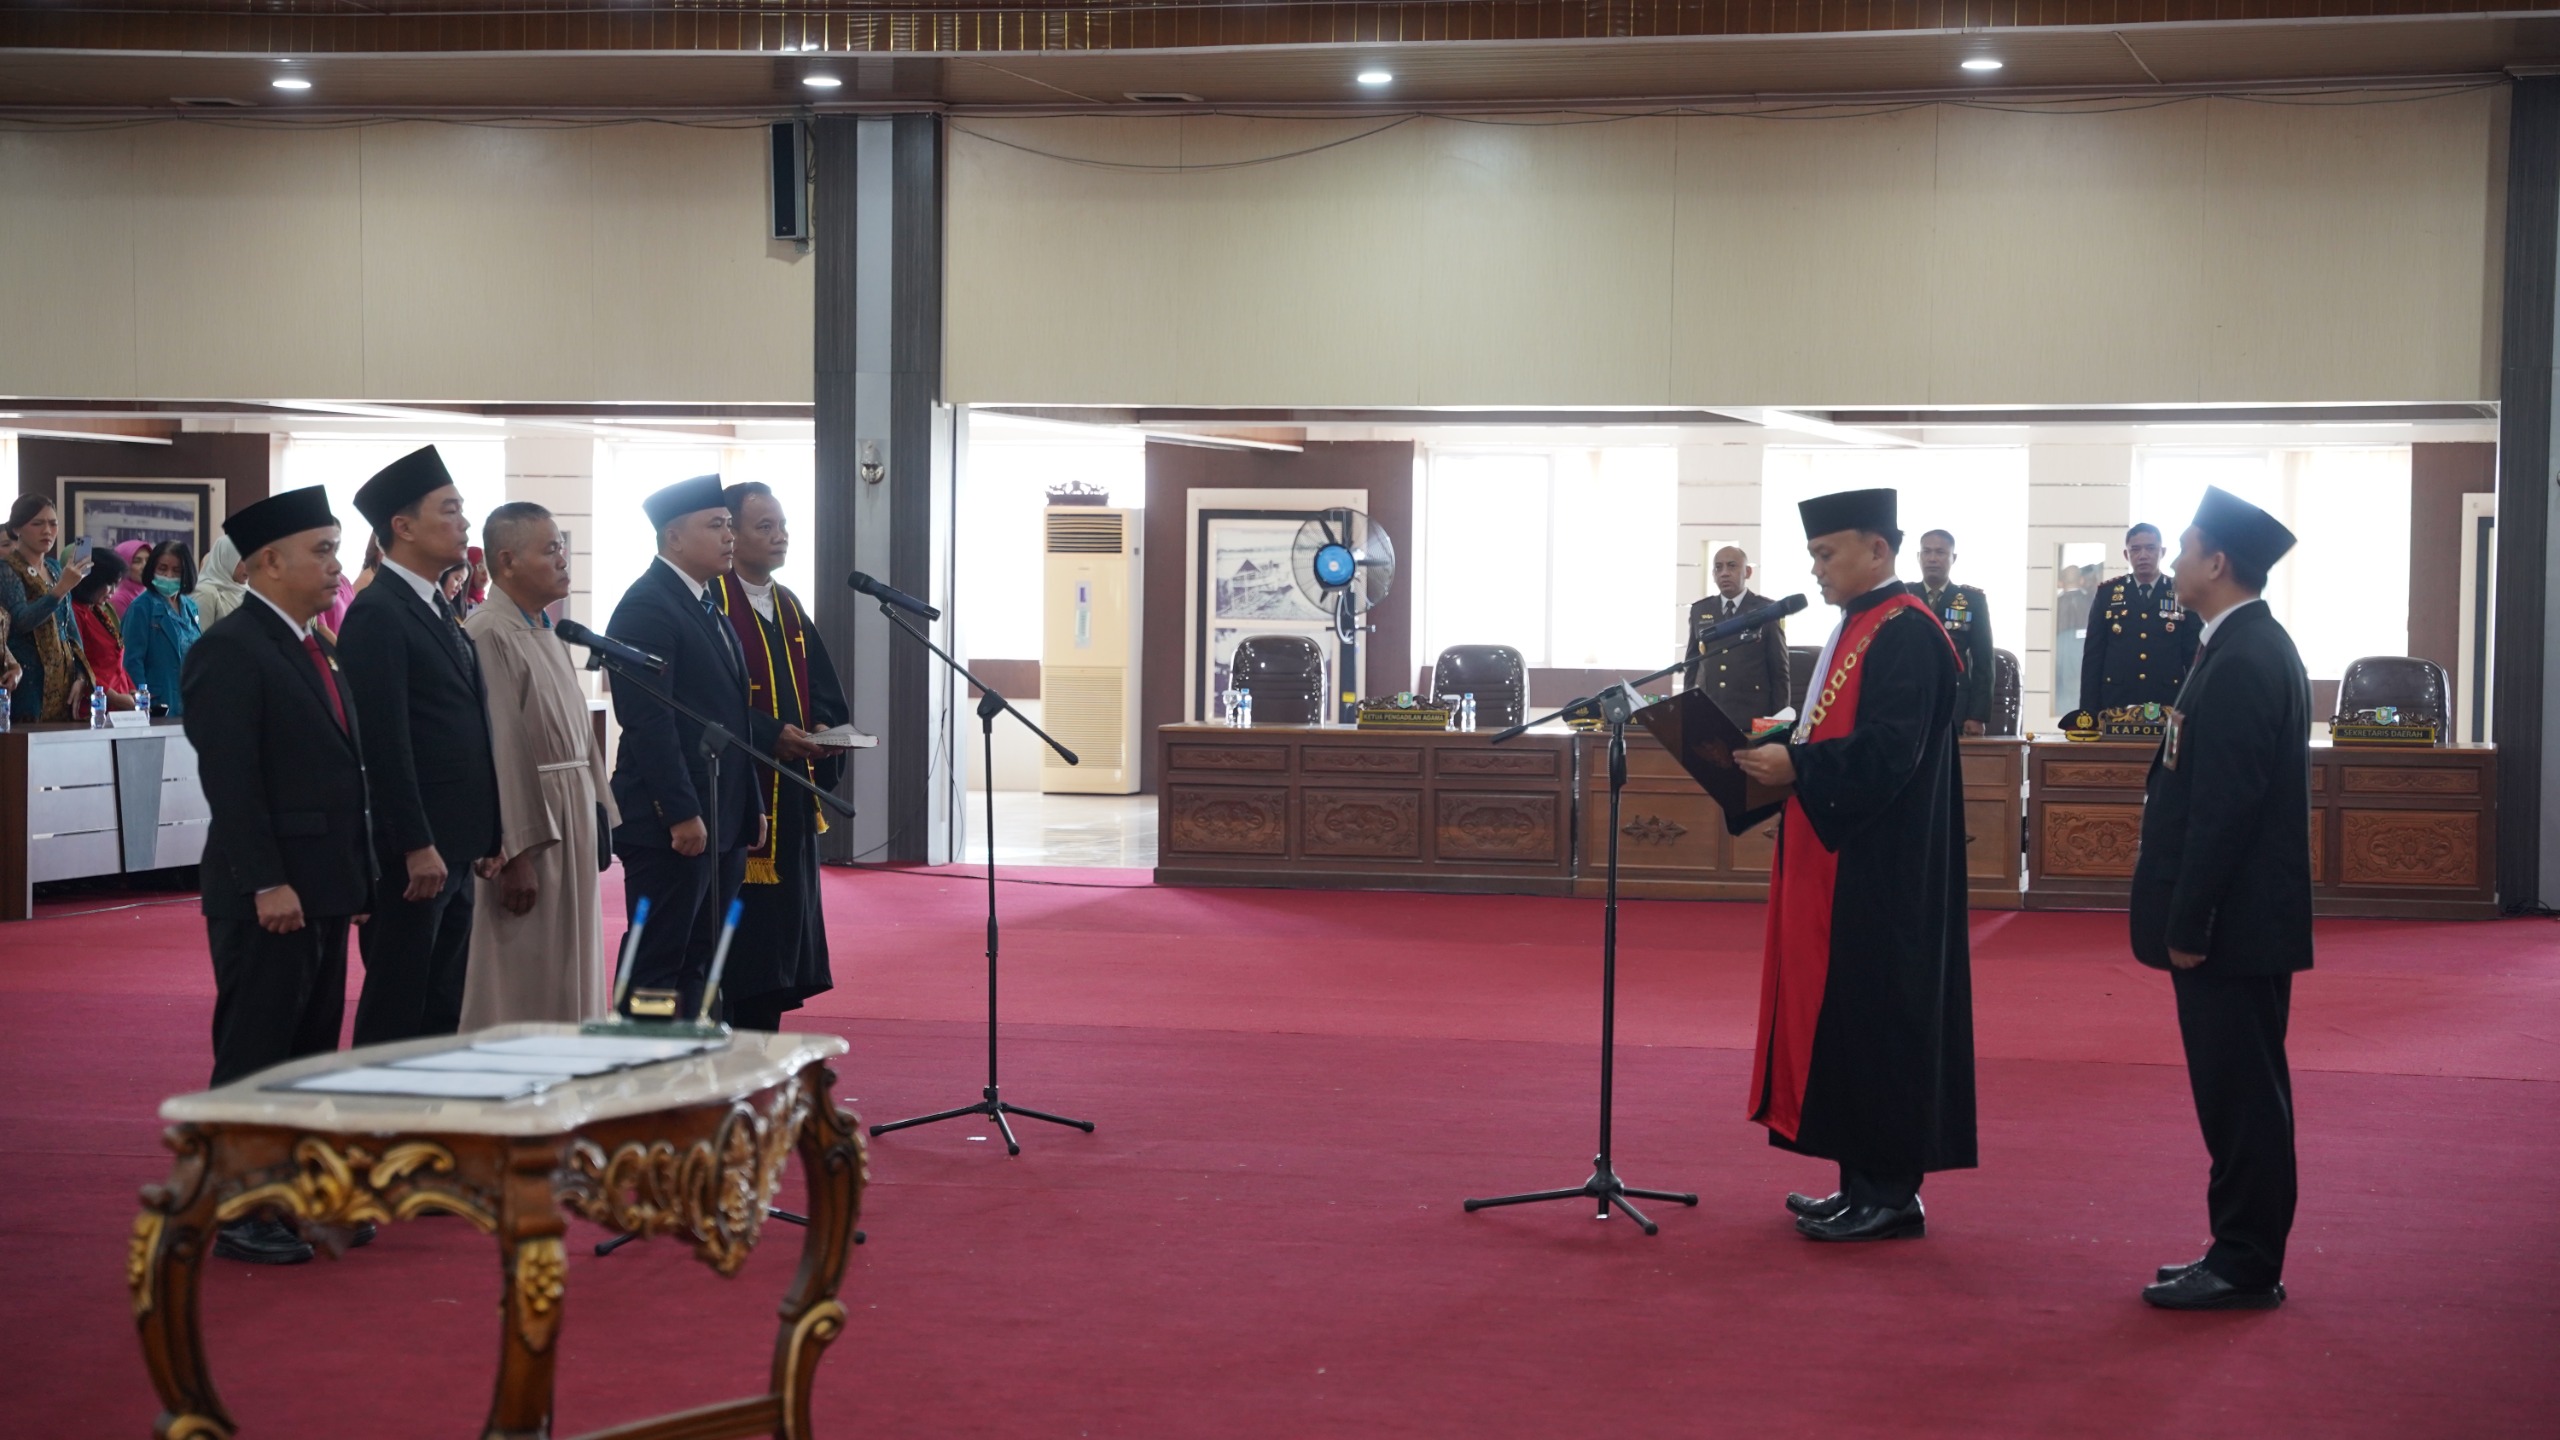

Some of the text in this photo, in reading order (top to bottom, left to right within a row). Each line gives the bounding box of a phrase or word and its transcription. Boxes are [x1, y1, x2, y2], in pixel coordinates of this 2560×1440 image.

[1384, 713, 1421, 721] PENGADILAN
[2111, 725, 2166, 735] KAPOL
[2343, 729, 2423, 738] SEKRETARIS DAERAH
